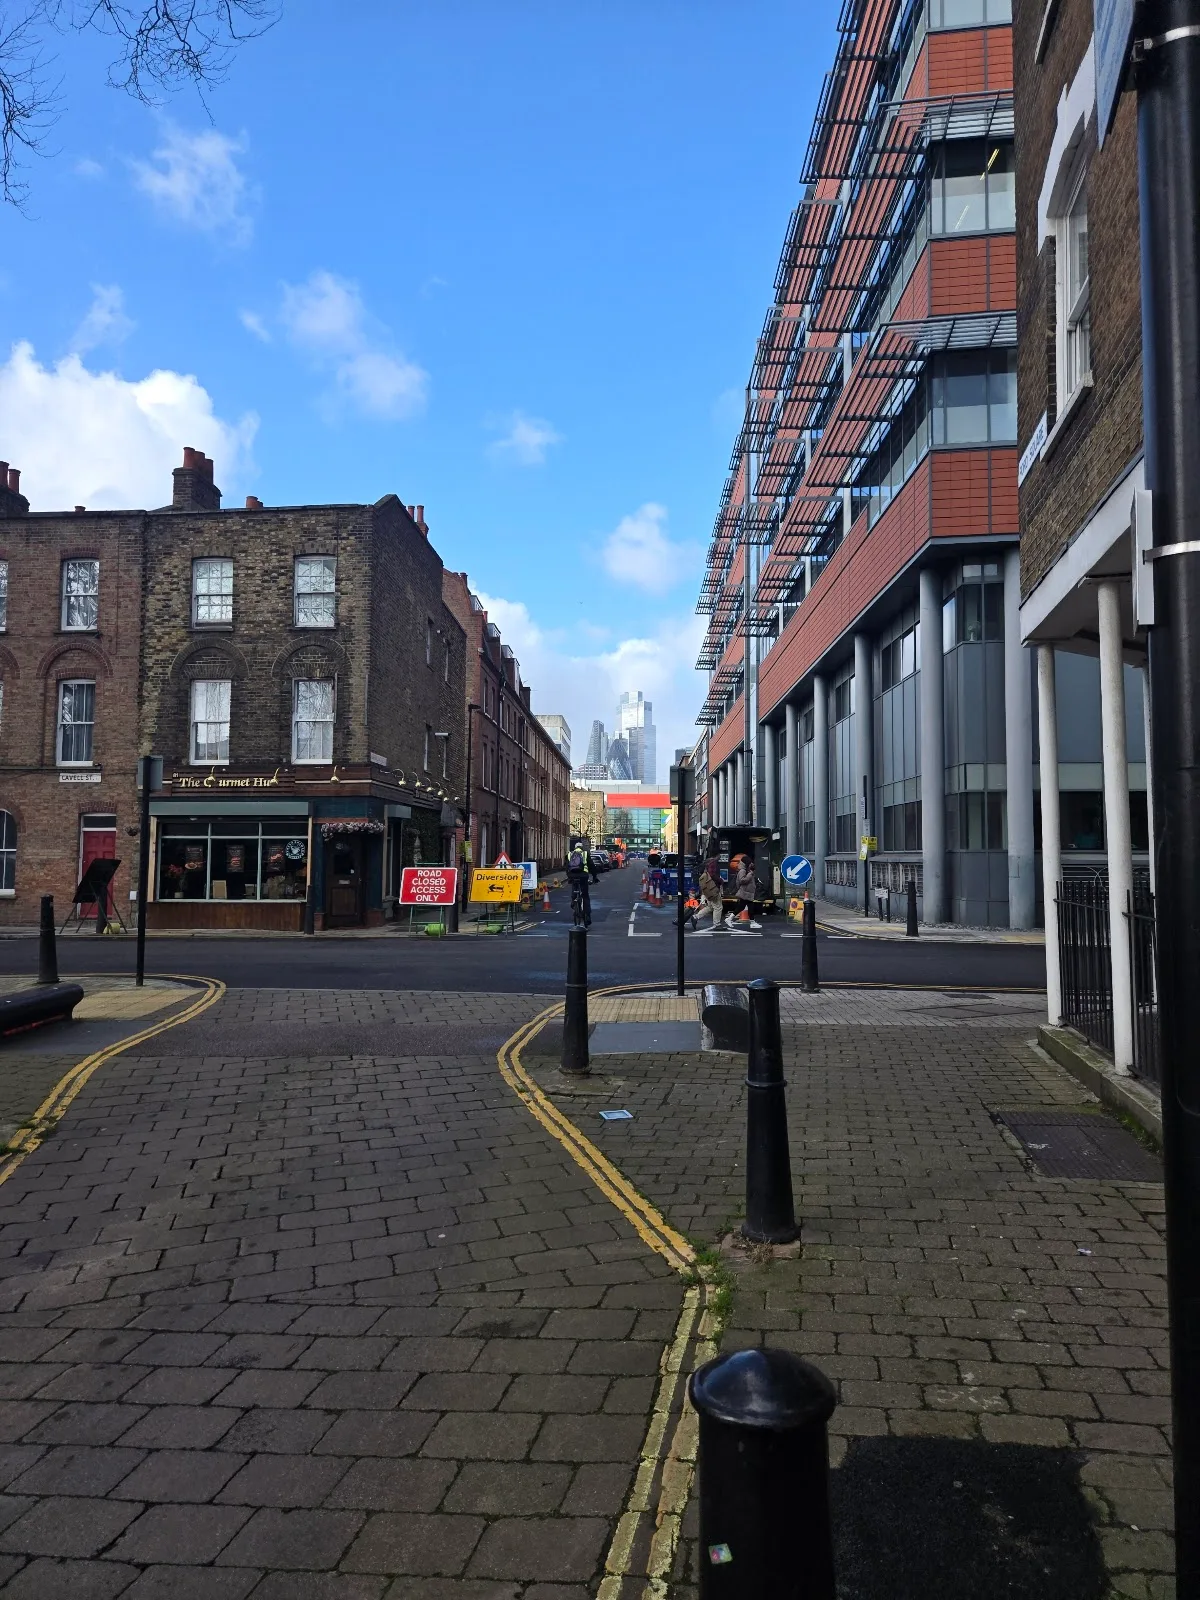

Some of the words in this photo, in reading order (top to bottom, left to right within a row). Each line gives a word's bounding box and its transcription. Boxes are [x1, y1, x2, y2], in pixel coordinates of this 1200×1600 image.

[179, 777, 200, 788] The
[203, 777, 250, 788] Gurmet
[253, 777, 275, 787] Hu
[411, 877, 446, 885] CLOSED
[476, 873, 519, 881] Diversion
[410, 886, 446, 894] ACCESS
[415, 894, 439, 902] ONLY
